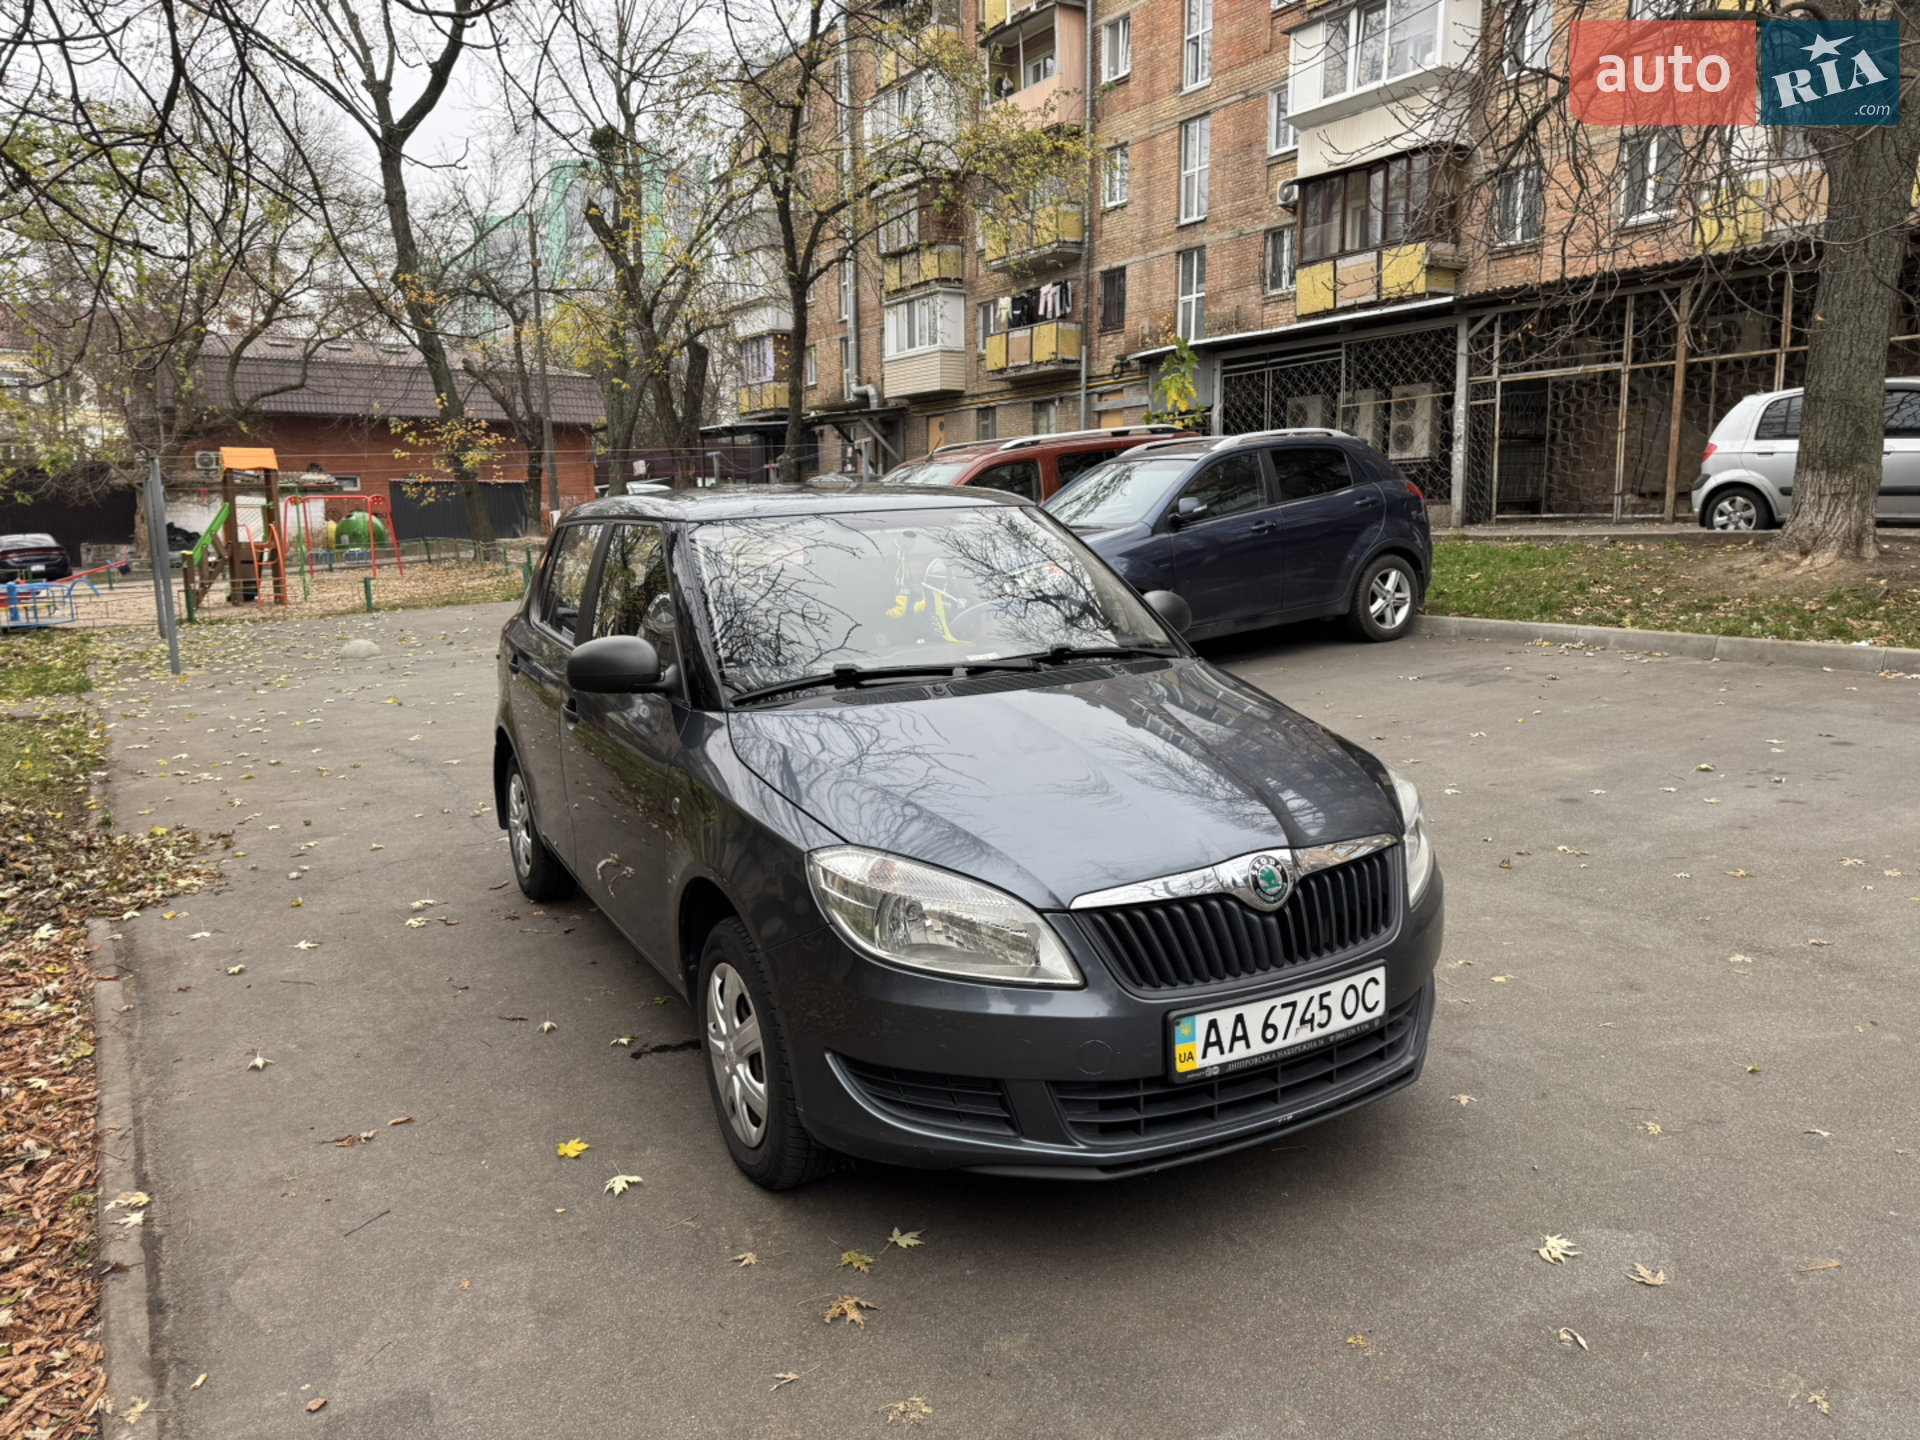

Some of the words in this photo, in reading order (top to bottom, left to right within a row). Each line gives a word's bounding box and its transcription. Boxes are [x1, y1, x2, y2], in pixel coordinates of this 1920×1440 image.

[1201, 1012, 1251, 1060] AA
[1261, 990, 1332, 1044] 6745
[1340, 976, 1380, 1020] OC
[1178, 1051, 1195, 1064] UA
